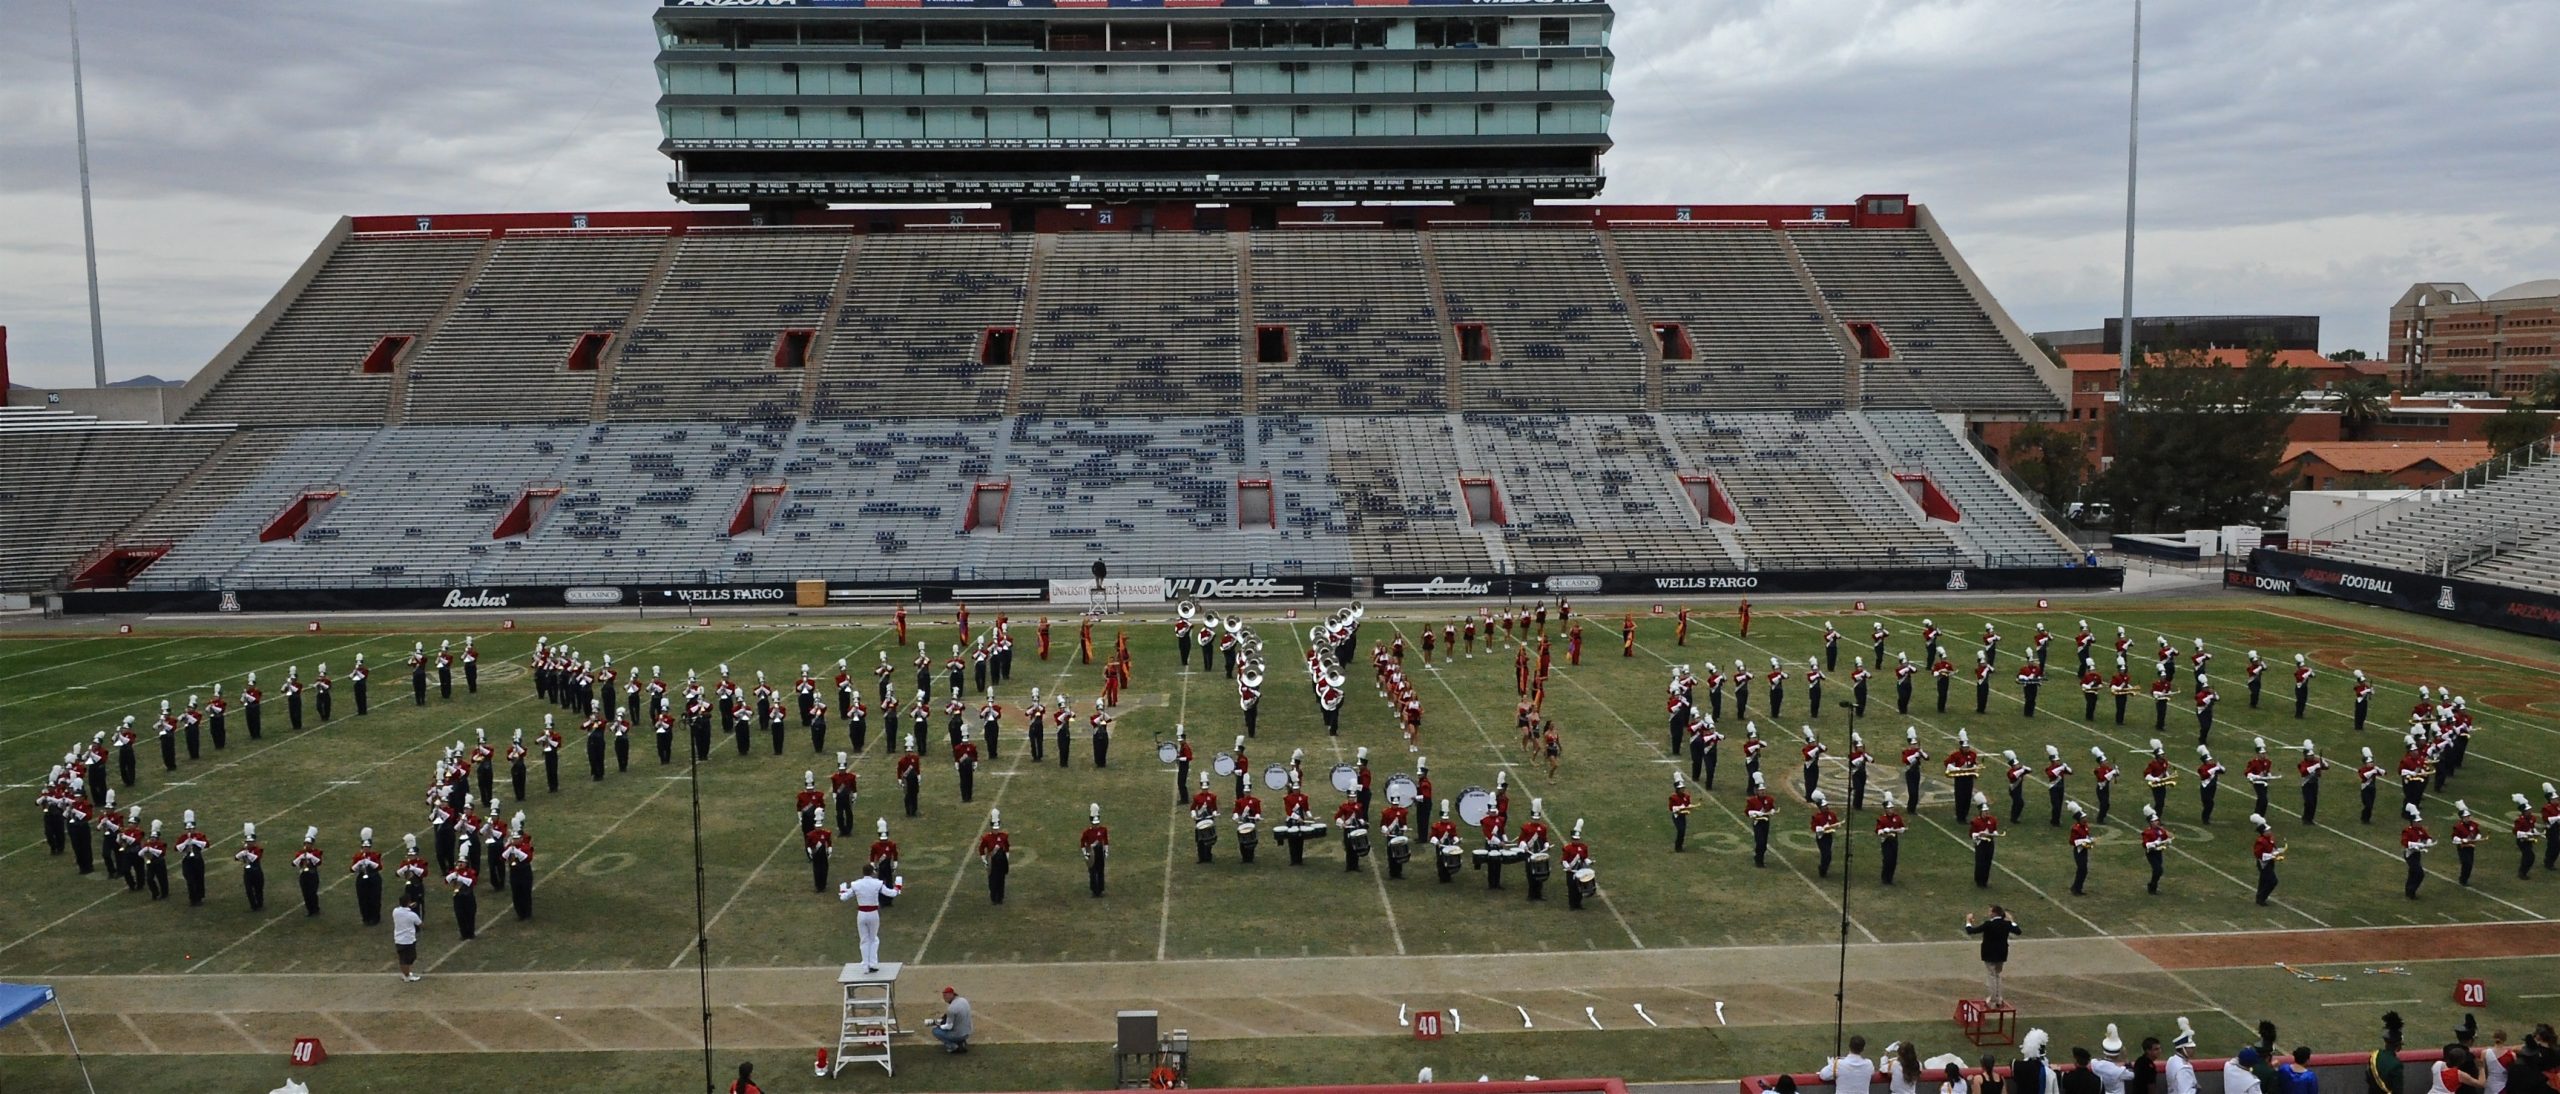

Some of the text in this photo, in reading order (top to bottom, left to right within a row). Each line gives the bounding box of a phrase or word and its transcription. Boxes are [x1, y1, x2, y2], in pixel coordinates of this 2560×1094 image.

[1100, 214, 1111, 224] 21
[1323, 213, 1335, 222] 22
[1677, 211, 1690, 221] 24
[1812, 211, 1825, 221] 25
[419, 221, 429, 231] 17
[574, 218, 586, 228] 18
[49, 393, 59, 402] 16
[1655, 577, 1758, 589] WELLS FARGO
[2255, 576, 2290, 593] DOWN
[2340, 574, 2393, 594] FOOTBALL
[677, 588, 784, 600] WELLS FARGO
[1128, 585, 1148, 595] BAND
[1148, 584, 1161, 594] DAY
[2463, 983, 2485, 1004] 20
[1418, 1016, 1437, 1036] 40
[293, 1042, 313, 1063] 40
